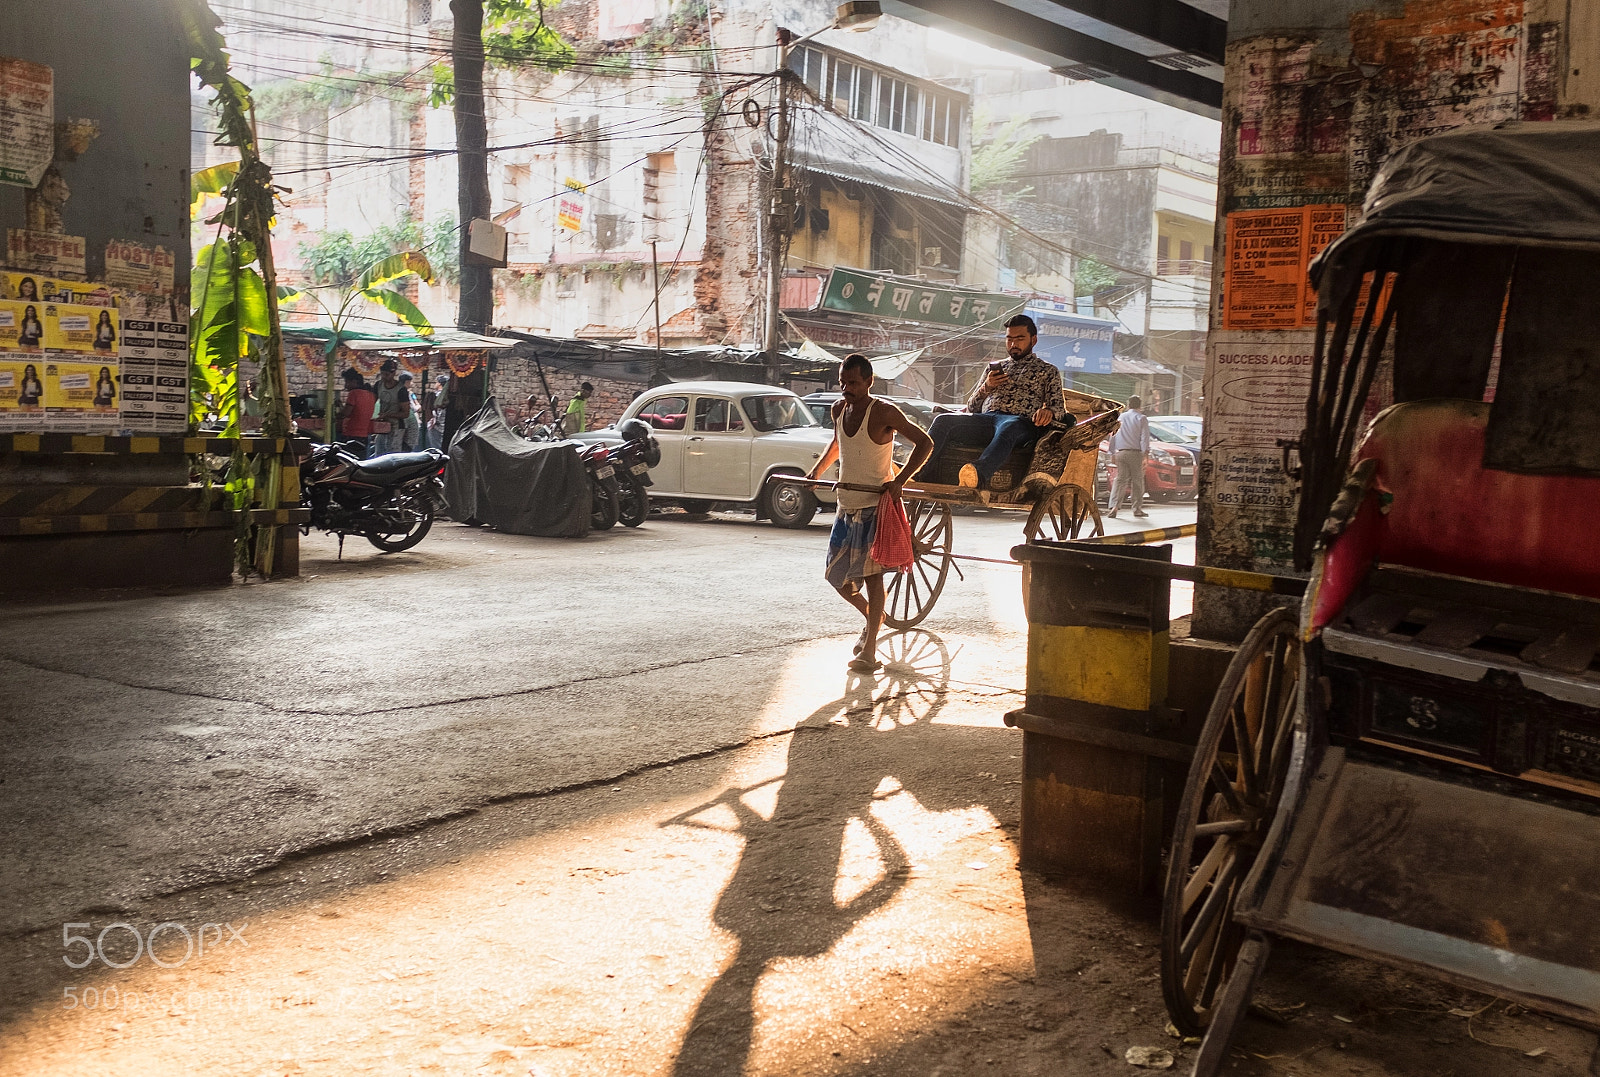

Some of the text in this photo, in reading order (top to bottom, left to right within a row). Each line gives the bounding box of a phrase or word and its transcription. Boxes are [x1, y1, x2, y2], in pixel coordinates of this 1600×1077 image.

[1273, 215, 1301, 227] CLASSES
[8, 235, 84, 259] HOSTEL
[1261, 236, 1300, 248] COMMERCE
[106, 244, 174, 268] HOSTEL
[1233, 251, 1243, 260] B.
[1246, 250, 1267, 259] COM
[866, 277, 937, 315] नेपाल
[129, 321, 151, 330] GST
[161, 323, 184, 333] GST
[1218, 353, 1269, 365] SUCCESS
[128, 375, 150, 384] GST
[161, 377, 183, 386] GST
[1217, 492, 1293, 507] 9831822932
[1559, 729, 1600, 744] RICKS
